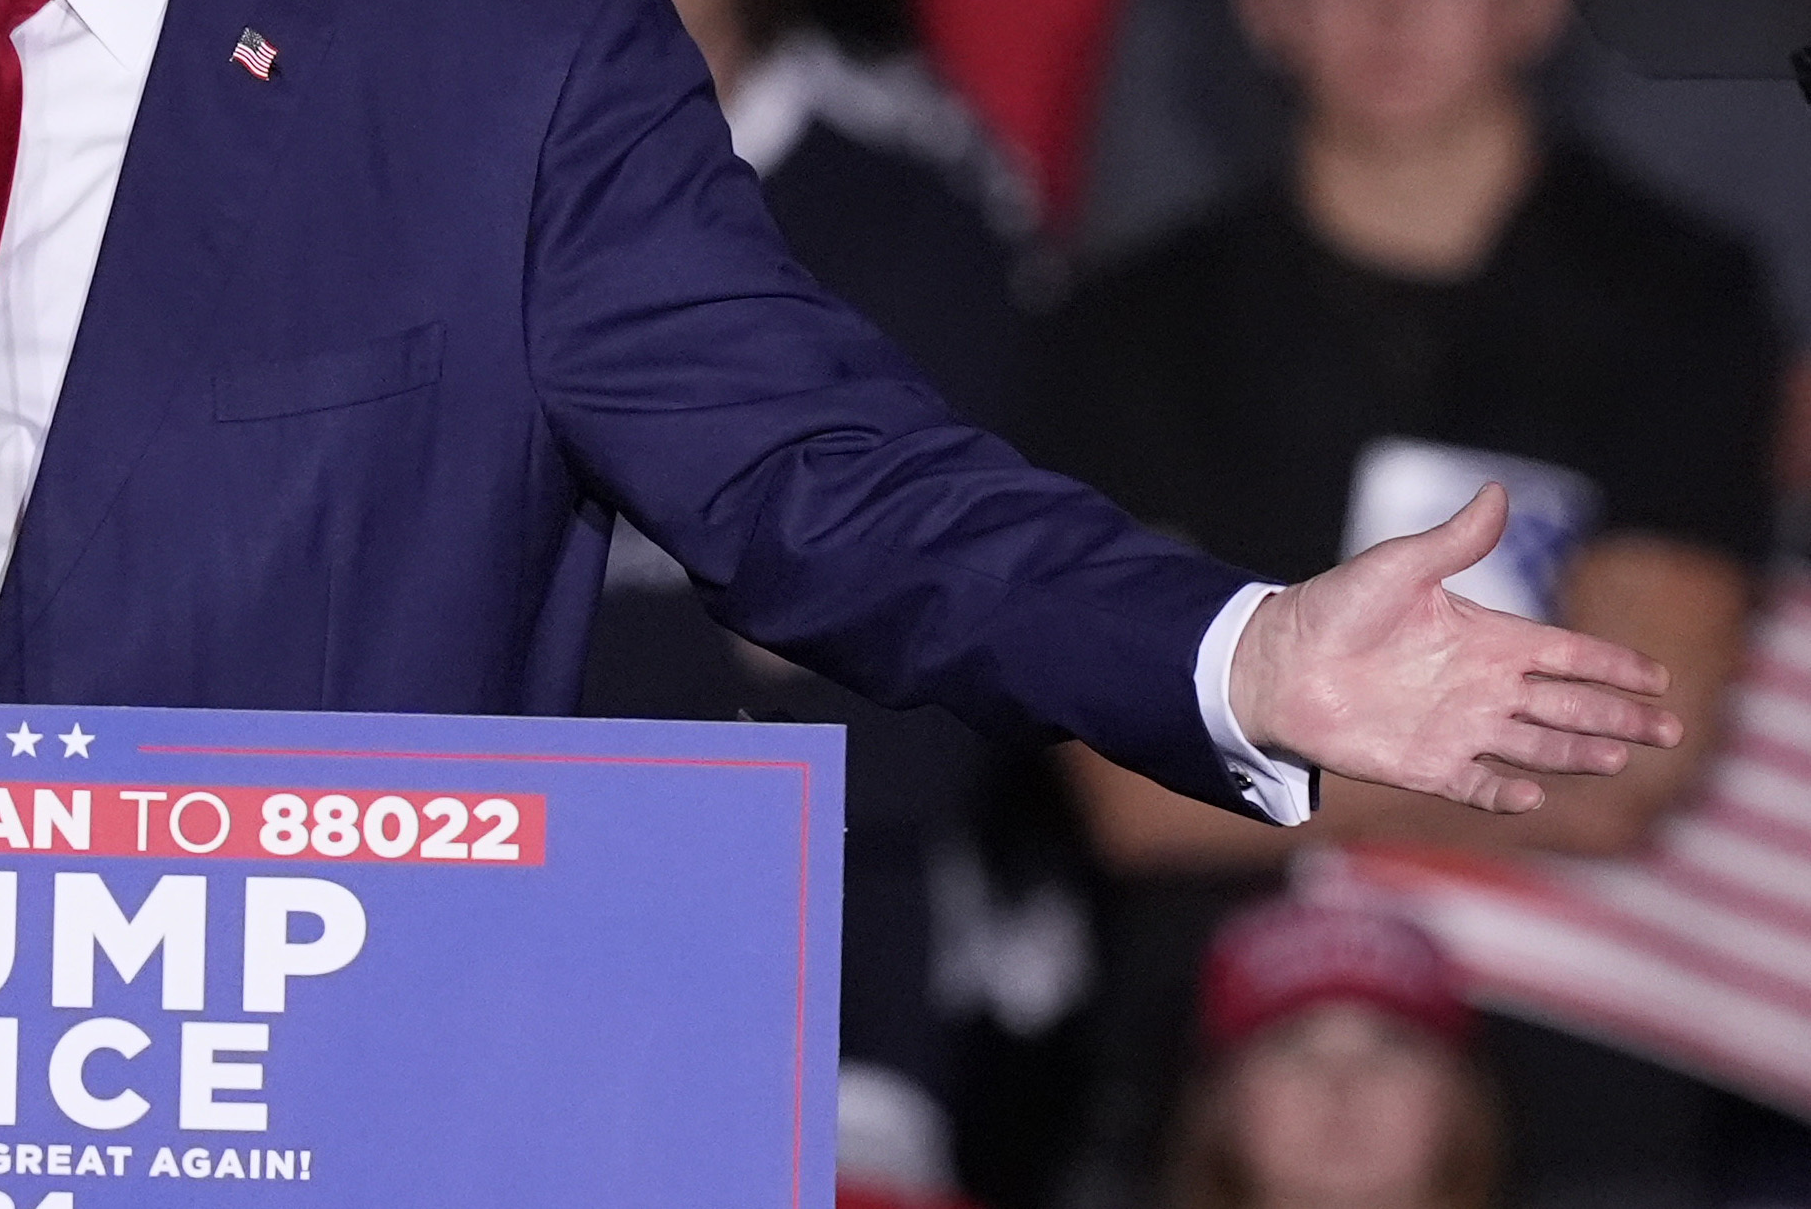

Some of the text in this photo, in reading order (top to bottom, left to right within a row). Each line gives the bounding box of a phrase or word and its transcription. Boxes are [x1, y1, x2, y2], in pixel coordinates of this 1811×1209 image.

[119, 790, 232, 854] TO
[259, 793, 520, 861] 88022
[148, 1146, 312, 1181] AGAIN!
